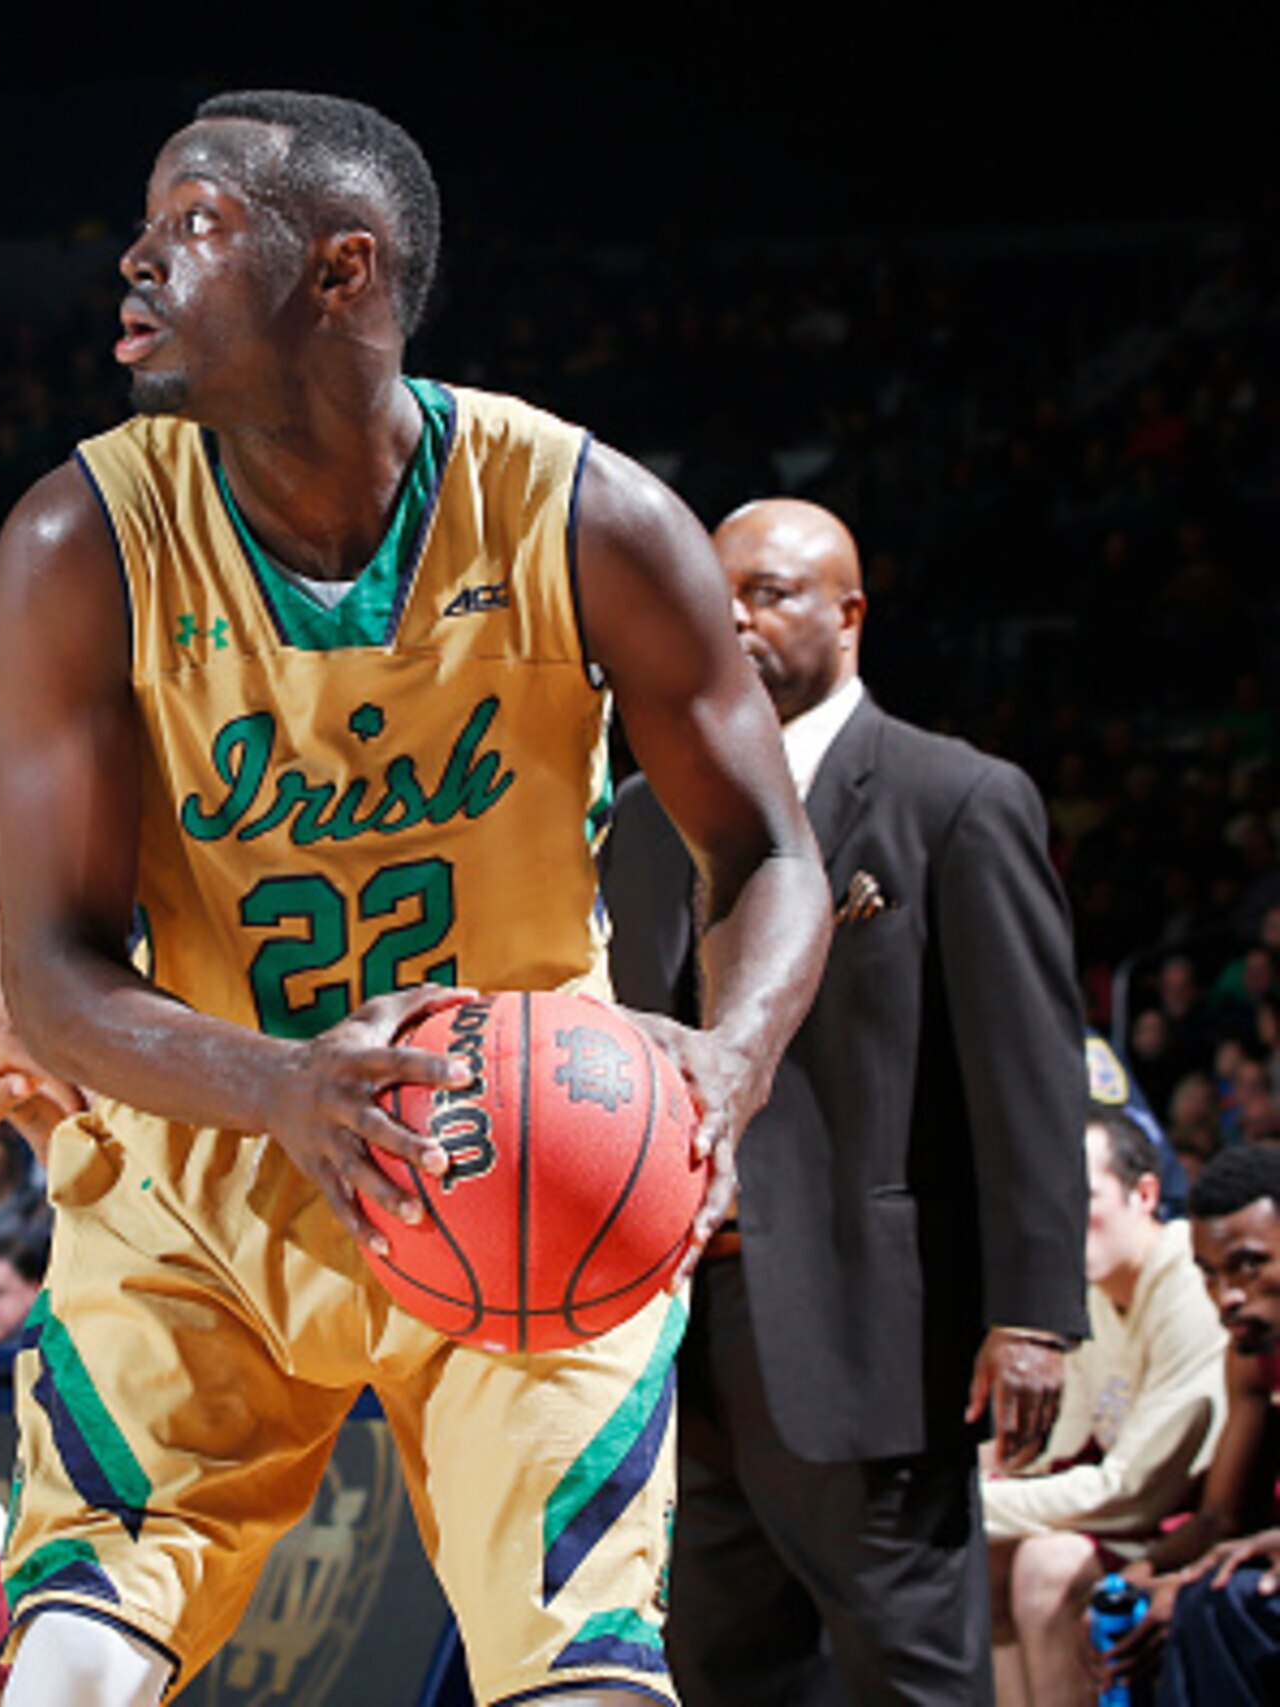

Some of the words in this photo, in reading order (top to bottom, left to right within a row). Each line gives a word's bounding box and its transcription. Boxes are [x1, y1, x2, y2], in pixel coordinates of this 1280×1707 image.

[443, 583, 510, 617] ACC
[181, 694, 515, 845] Irish
[238, 855, 458, 1040] 22
